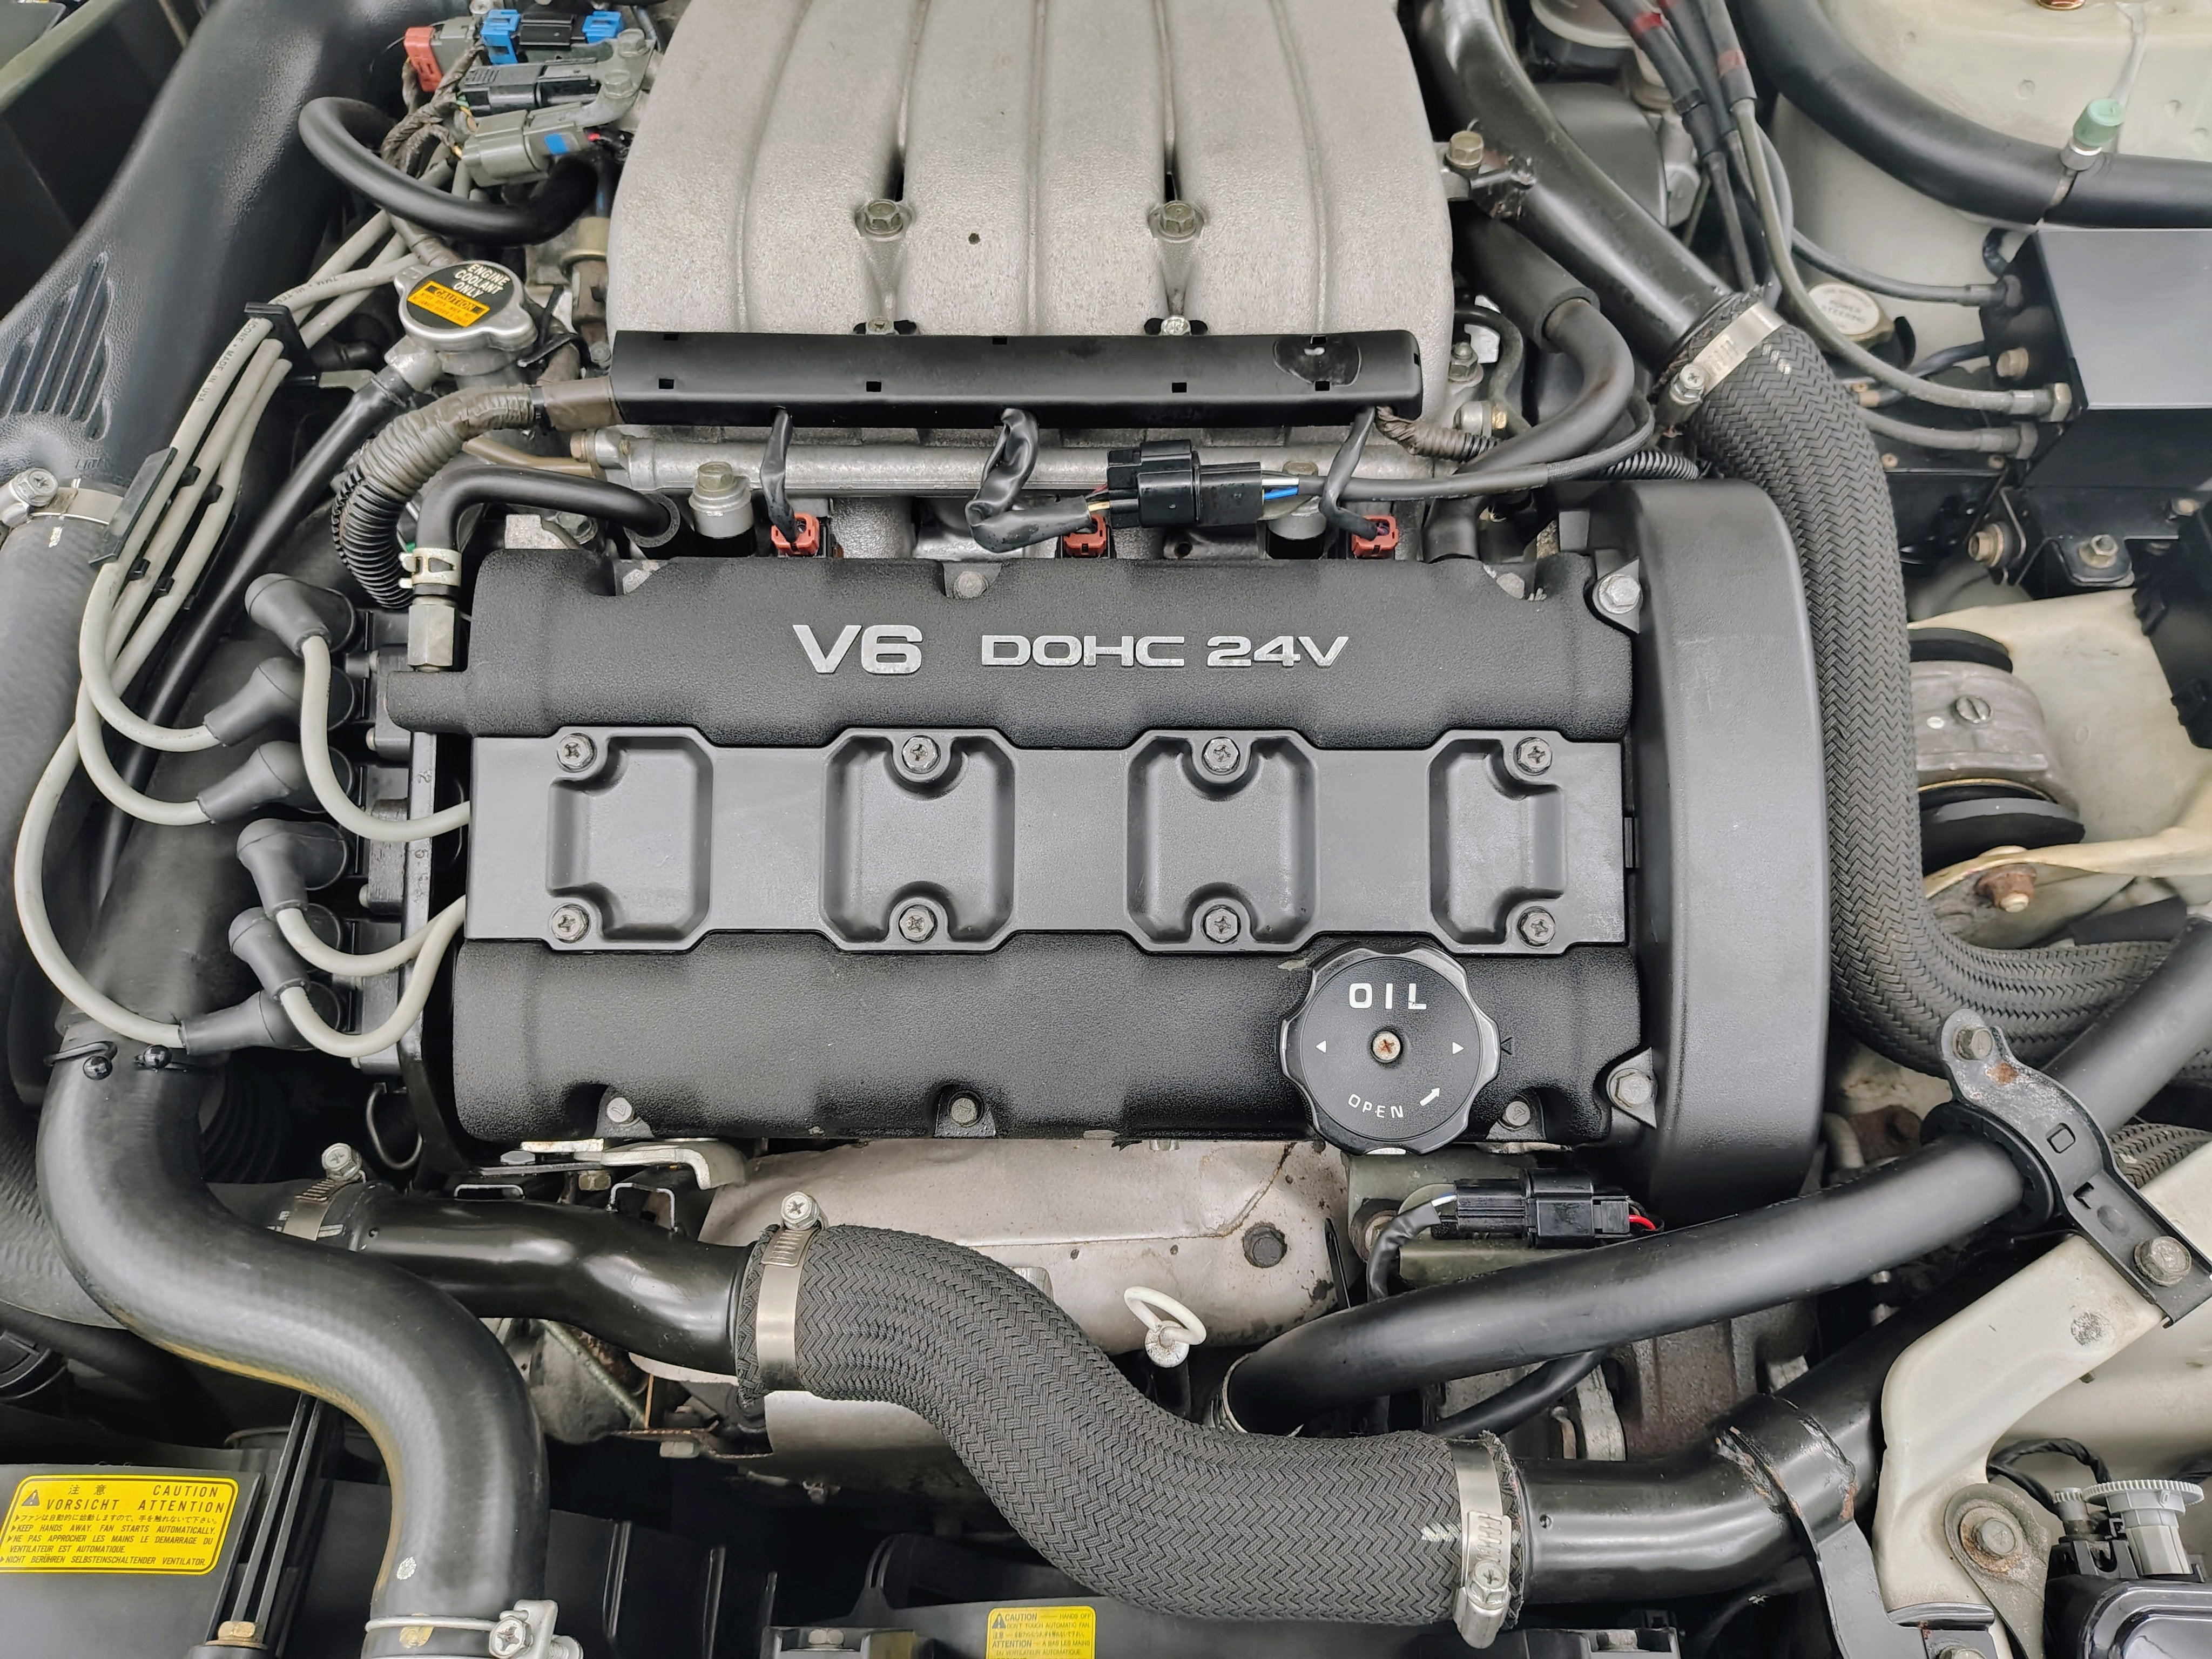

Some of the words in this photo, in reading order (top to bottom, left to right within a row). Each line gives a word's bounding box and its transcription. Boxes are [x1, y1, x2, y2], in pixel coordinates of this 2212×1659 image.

[454, 269, 504, 294] COOLANT
[468, 263, 510, 286] ENGINE
[453, 281, 484, 298] ONLY
[434, 288, 476, 311] CAUTION
[215, 350, 235, 371] MADE
[207, 375, 218, 383] IN
[196, 388, 210, 402] USA
[793, 624, 923, 675] V6
[981, 635, 1185, 667] DOHC
[1206, 635, 1350, 667] 24V
[1349, 983, 1427, 1010] OIL
[1348, 1094, 1404, 1118] OPEN
[153, 1485, 219, 1498] CAUTION
[46, 1499, 120, 1510] VORSICHT
[137, 1499, 225, 1513] ATTENTION
[16, 1524, 34, 1532] KEEP
[39, 1524, 63, 1532] HANDS
[69, 1524, 92, 1532] AWAY.
[99, 1524, 115, 1532] FAN
[121, 1525, 150, 1533] STARTS
[156, 1526, 215, 1535] AUTOMATICALLY.
[13, 1534, 24, 1542] NE
[27, 1534, 43, 1542] PAS
[47, 1534, 87, 1542] APPROCHER
[92, 1534, 106, 1542] LES
[154, 1536, 198, 1545] DEMARRAGE
[5, 1555, 26, 1564] NICHT
[30, 1553, 66, 1564] BERÜHREN
[70, 1555, 157, 1564] SELBSTEINSCHALTENDER
[162, 1556, 206, 1566] VENTILATOR.
[1004, 1613, 1037, 1621] CAUTION
[992, 1640, 1032, 1649] ATTENTION
